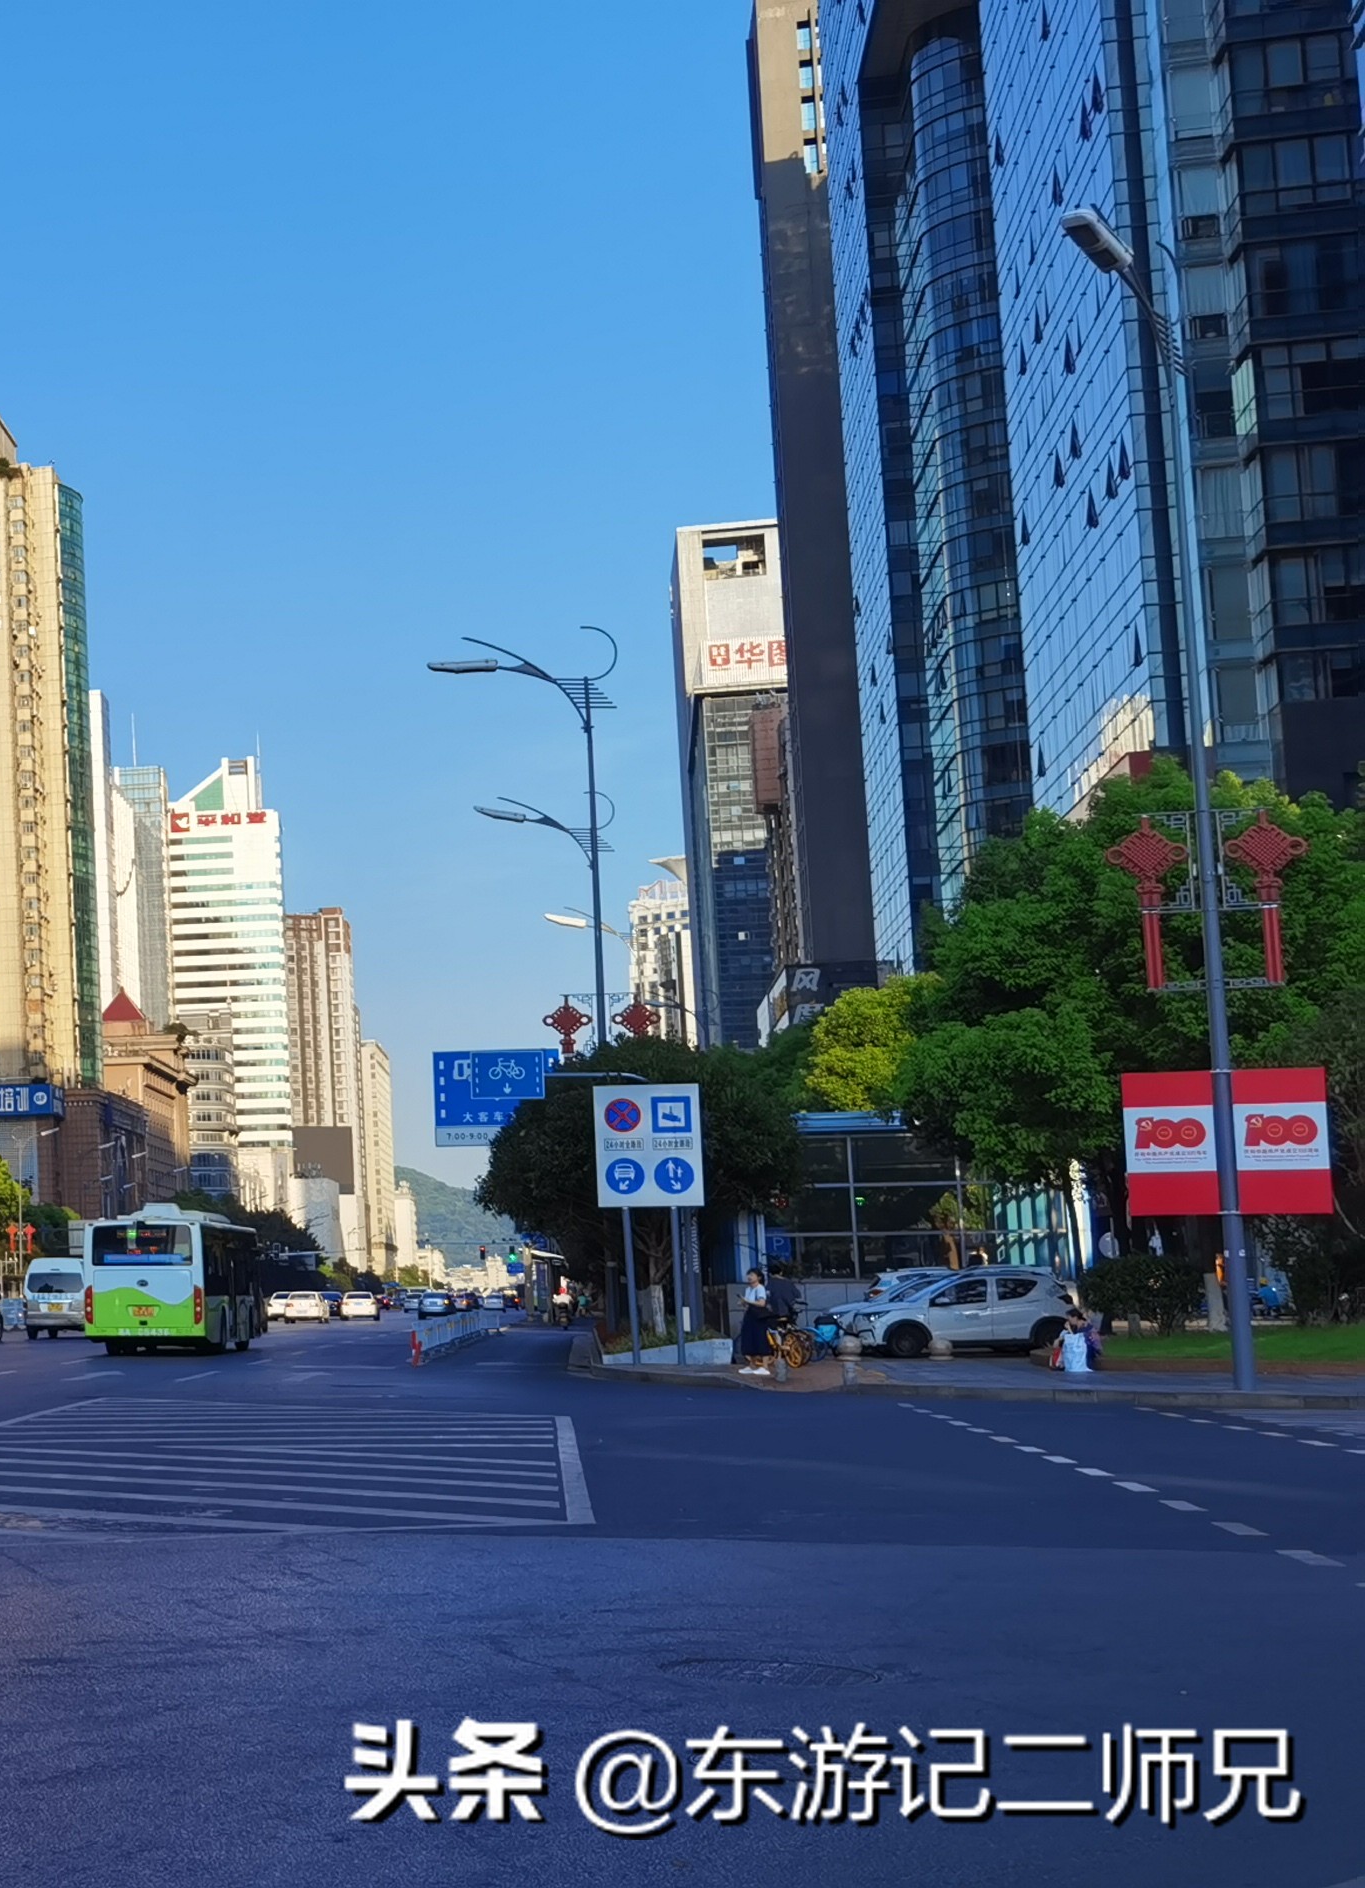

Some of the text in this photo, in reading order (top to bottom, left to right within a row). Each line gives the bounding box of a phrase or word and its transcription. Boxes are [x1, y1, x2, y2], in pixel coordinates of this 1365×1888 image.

[734, 641, 786, 669] 华图
[0, 1087, 29, 1112] 培训
[1135, 1117, 1206, 1149] 100
[1242, 1114, 1318, 1147] 100
[773, 1237, 785, 1251] P
